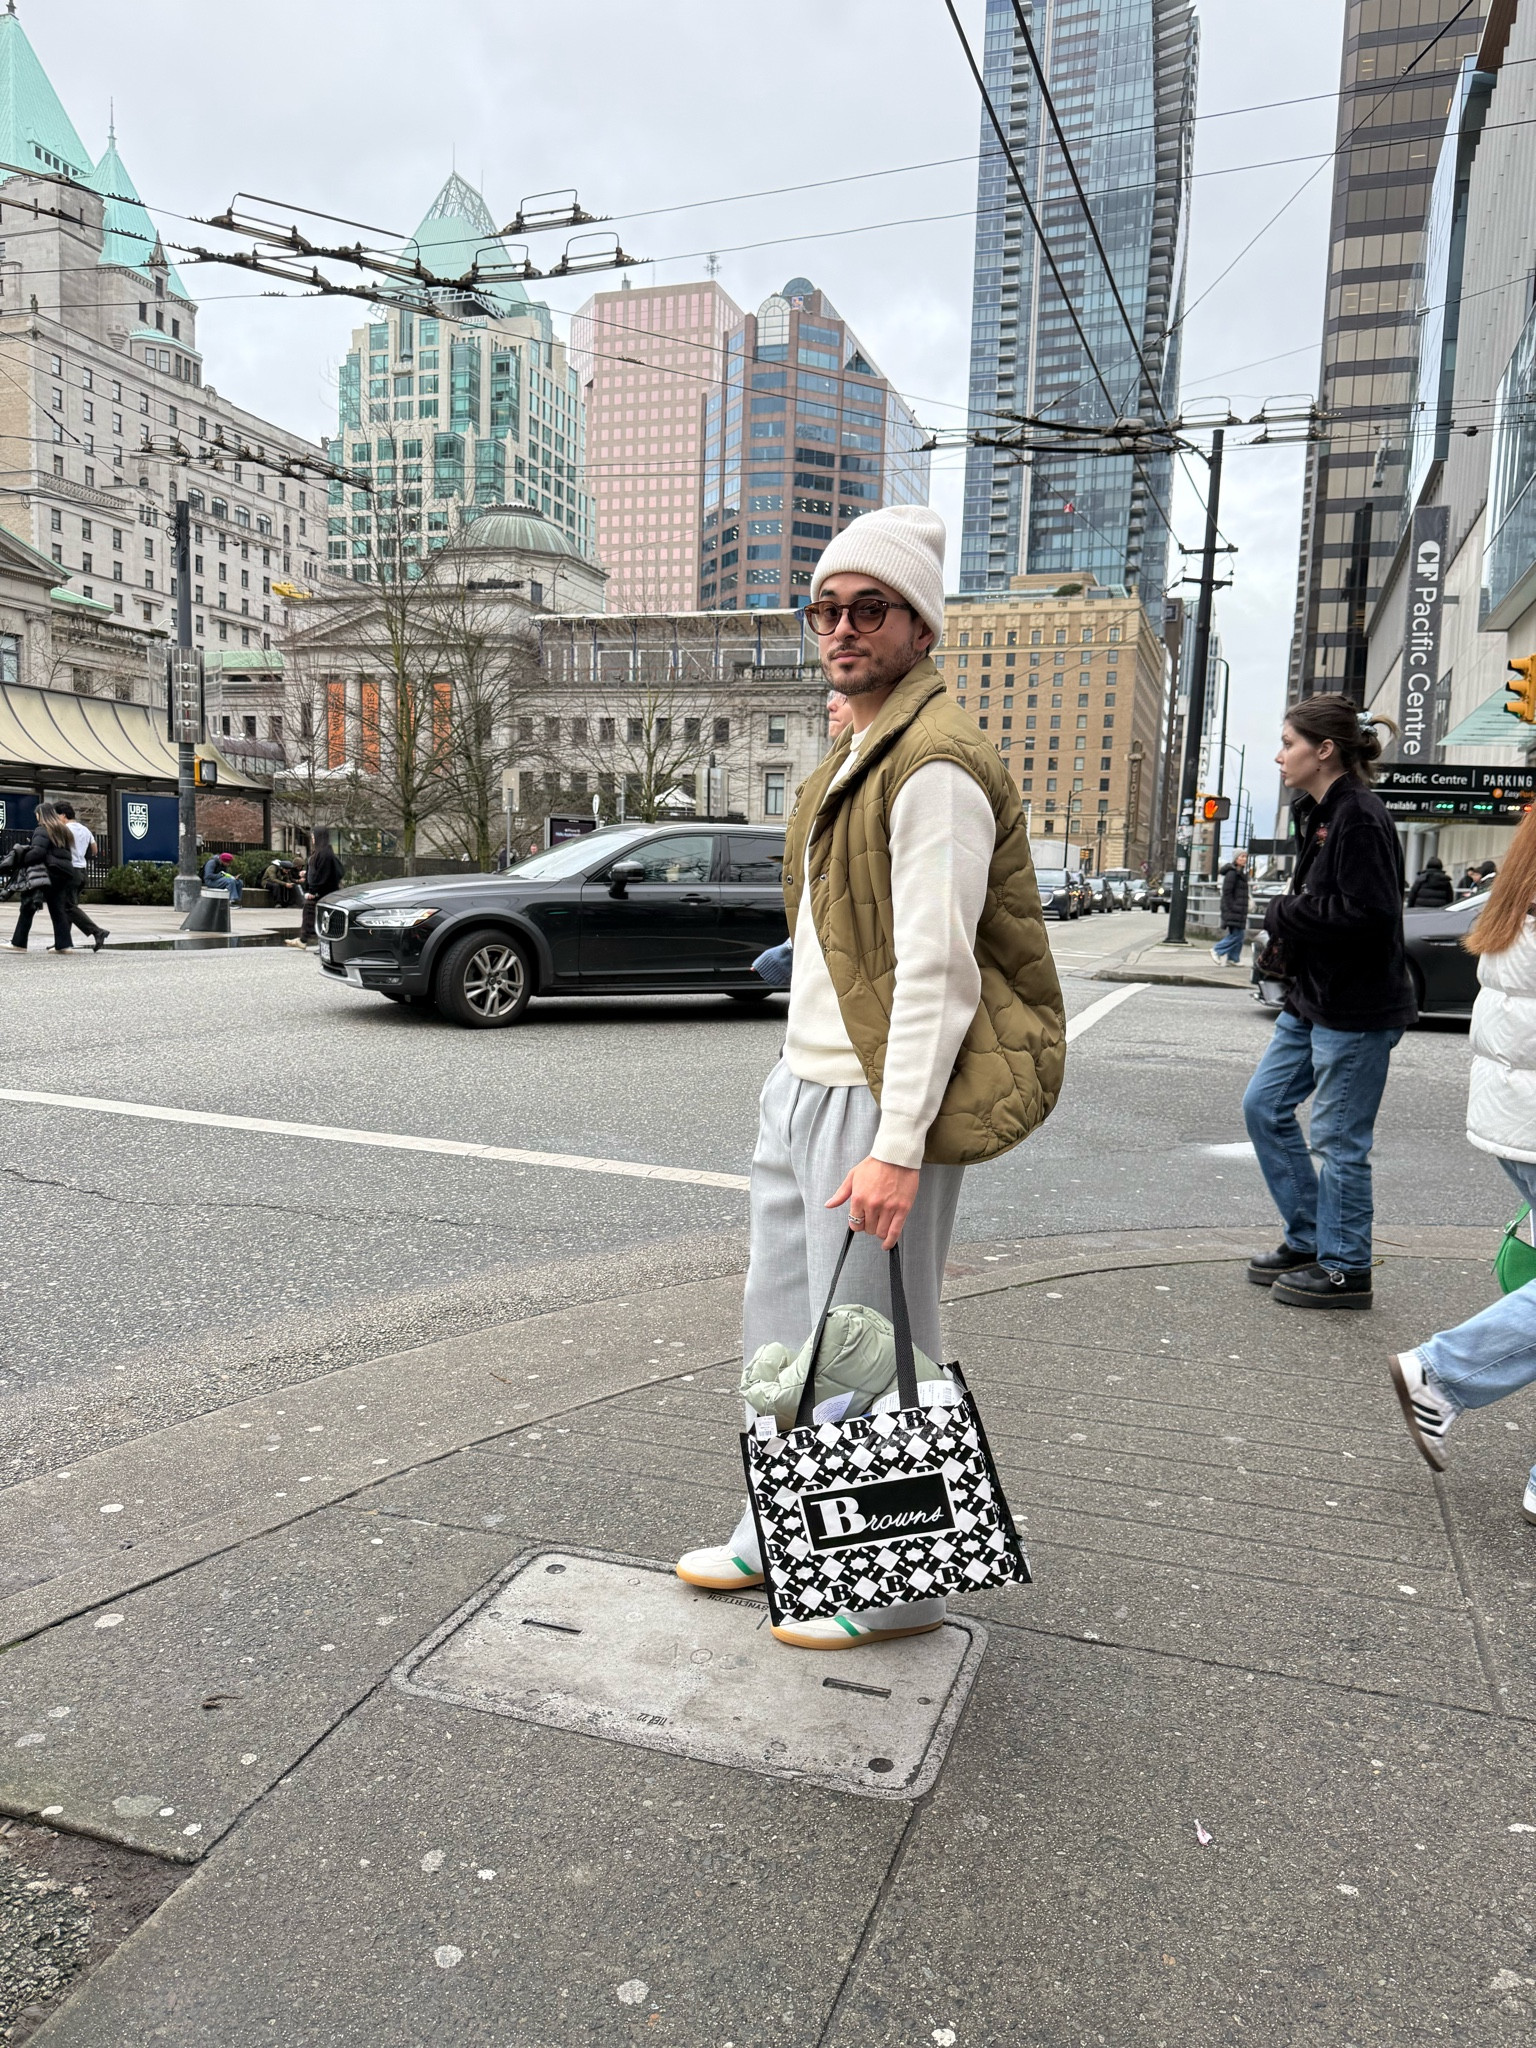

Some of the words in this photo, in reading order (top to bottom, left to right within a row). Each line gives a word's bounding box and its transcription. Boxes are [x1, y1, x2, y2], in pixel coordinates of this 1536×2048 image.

[1410, 587, 1437, 666] Pacific
[1403, 673, 1431, 755] Centre
[1393, 772, 1428, 785] Pacific
[1431, 774, 1467, 785] Centre
[1482, 774, 1533, 787] PARKING
[130, 805, 147, 815] UBC
[1386, 801, 1417, 811] Available
[810, 1496, 945, 1540] Browns
[707, 1594, 769, 1610] SYNERTECH
